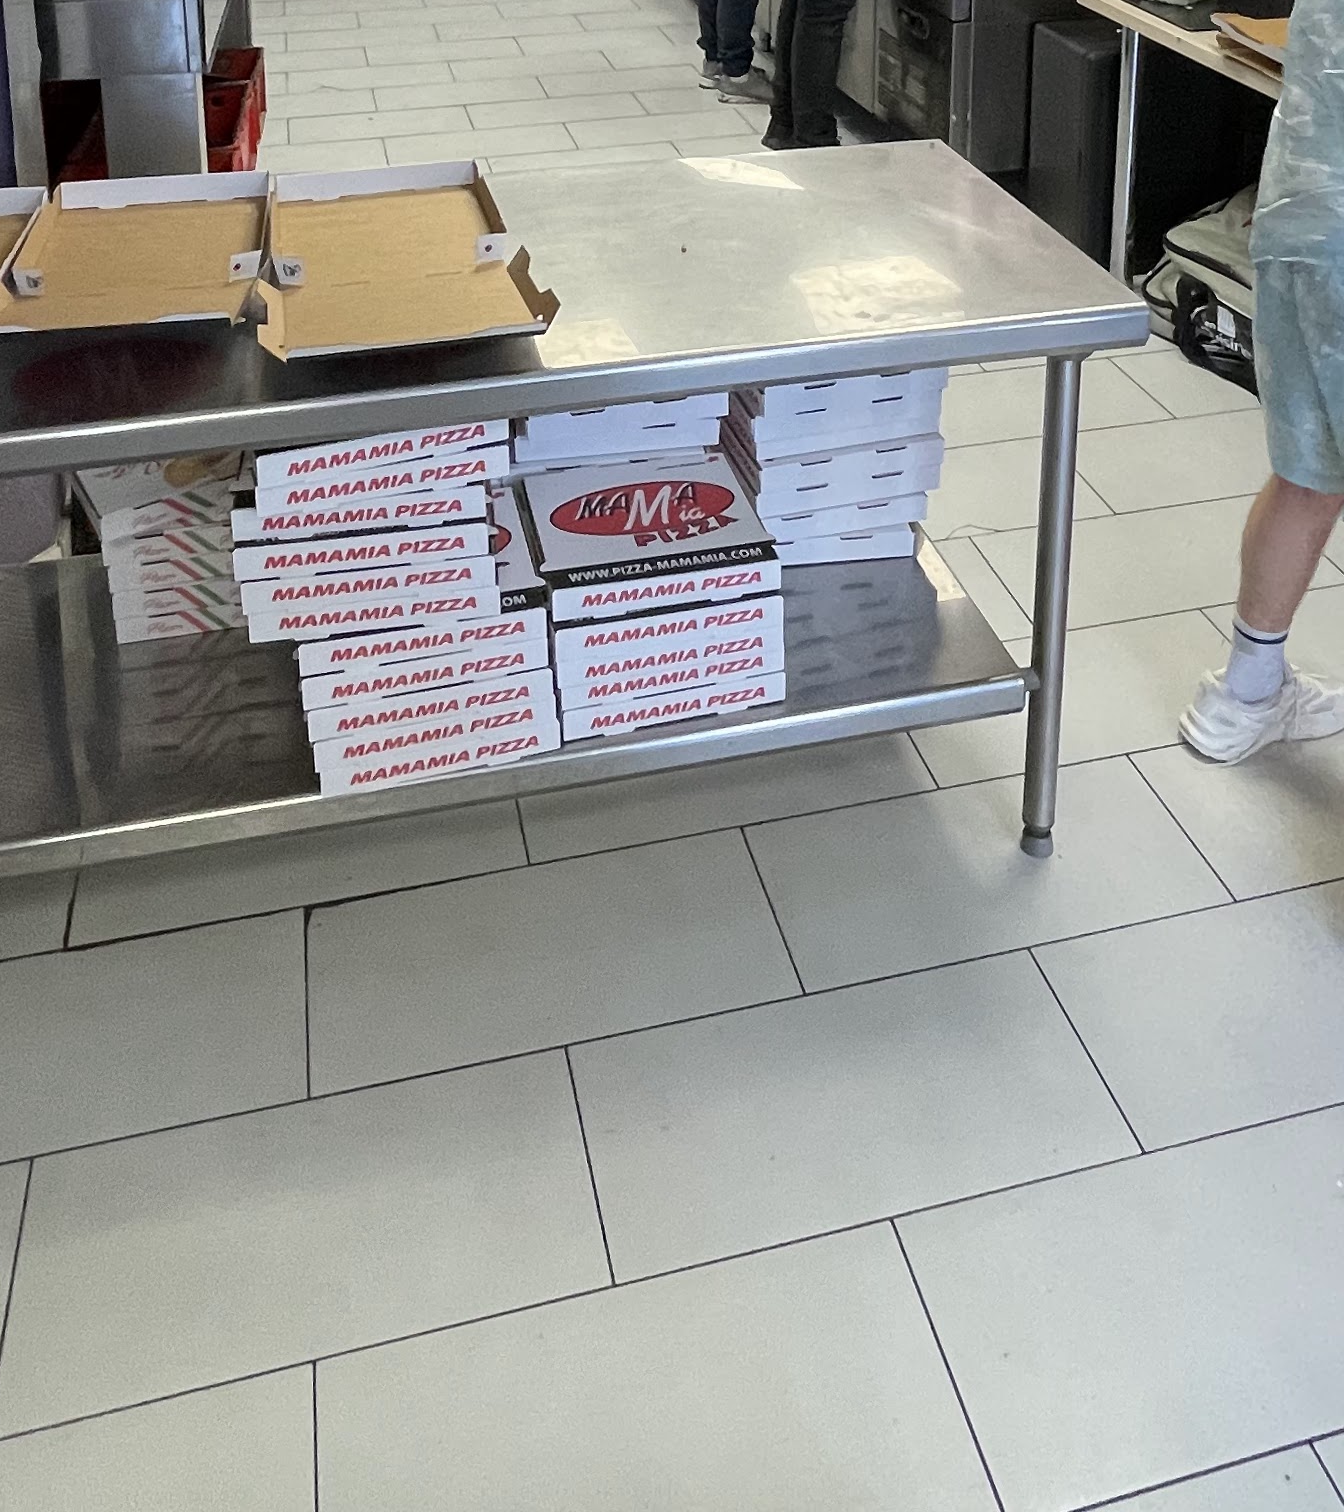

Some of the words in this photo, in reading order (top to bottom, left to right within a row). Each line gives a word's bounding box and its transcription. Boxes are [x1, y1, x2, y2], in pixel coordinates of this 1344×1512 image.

[287, 439, 414, 477] MAMAMIA
[420, 424, 486, 449] PIZZA
[286, 472, 414, 505] MAMAMIA
[419, 460, 487, 482] PIZZA
[262, 507, 389, 531] MAMAMIA
[395, 499, 463, 518] PIZZA
[264, 544, 391, 569] MAMAMIA
[397, 536, 465, 556] PIZZA
[567, 546, 764, 583] WWW.PIZZA-MAMAMIA.COM
[271, 576, 399, 602] MAMAMIA
[404, 567, 472, 587] PIZZA
[581, 580, 696, 607] MAMAMIA
[701, 571, 762, 590] PIZZA
[278, 605, 404, 630] MAMAMIA
[410, 596, 477, 615] PIZZA
[584, 619, 698, 647] MAMAMIA
[703, 608, 764, 629] PIZZA
[330, 633, 454, 662] MAMAMIA
[460, 621, 526, 643] PIZZA
[585, 648, 698, 678] MAMAMIA
[703, 636, 764, 657] PIZZA
[331, 665, 454, 699] MAMAMIA
[460, 652, 525, 675] PIZZA
[587, 668, 699, 699] MAMAMIA
[704, 656, 764, 677] PIZZA
[336, 699, 460, 732] MAMAMIA
[465, 685, 530, 708] PIZZA
[590, 699, 702, 730] MAMAMIA
[707, 687, 766, 708] PIZZA
[342, 723, 464, 759] MAMAMIA
[469, 708, 534, 732] PIZZA
[350, 749, 470, 785] MAMAMIA
[475, 735, 539, 759] PIZZA
